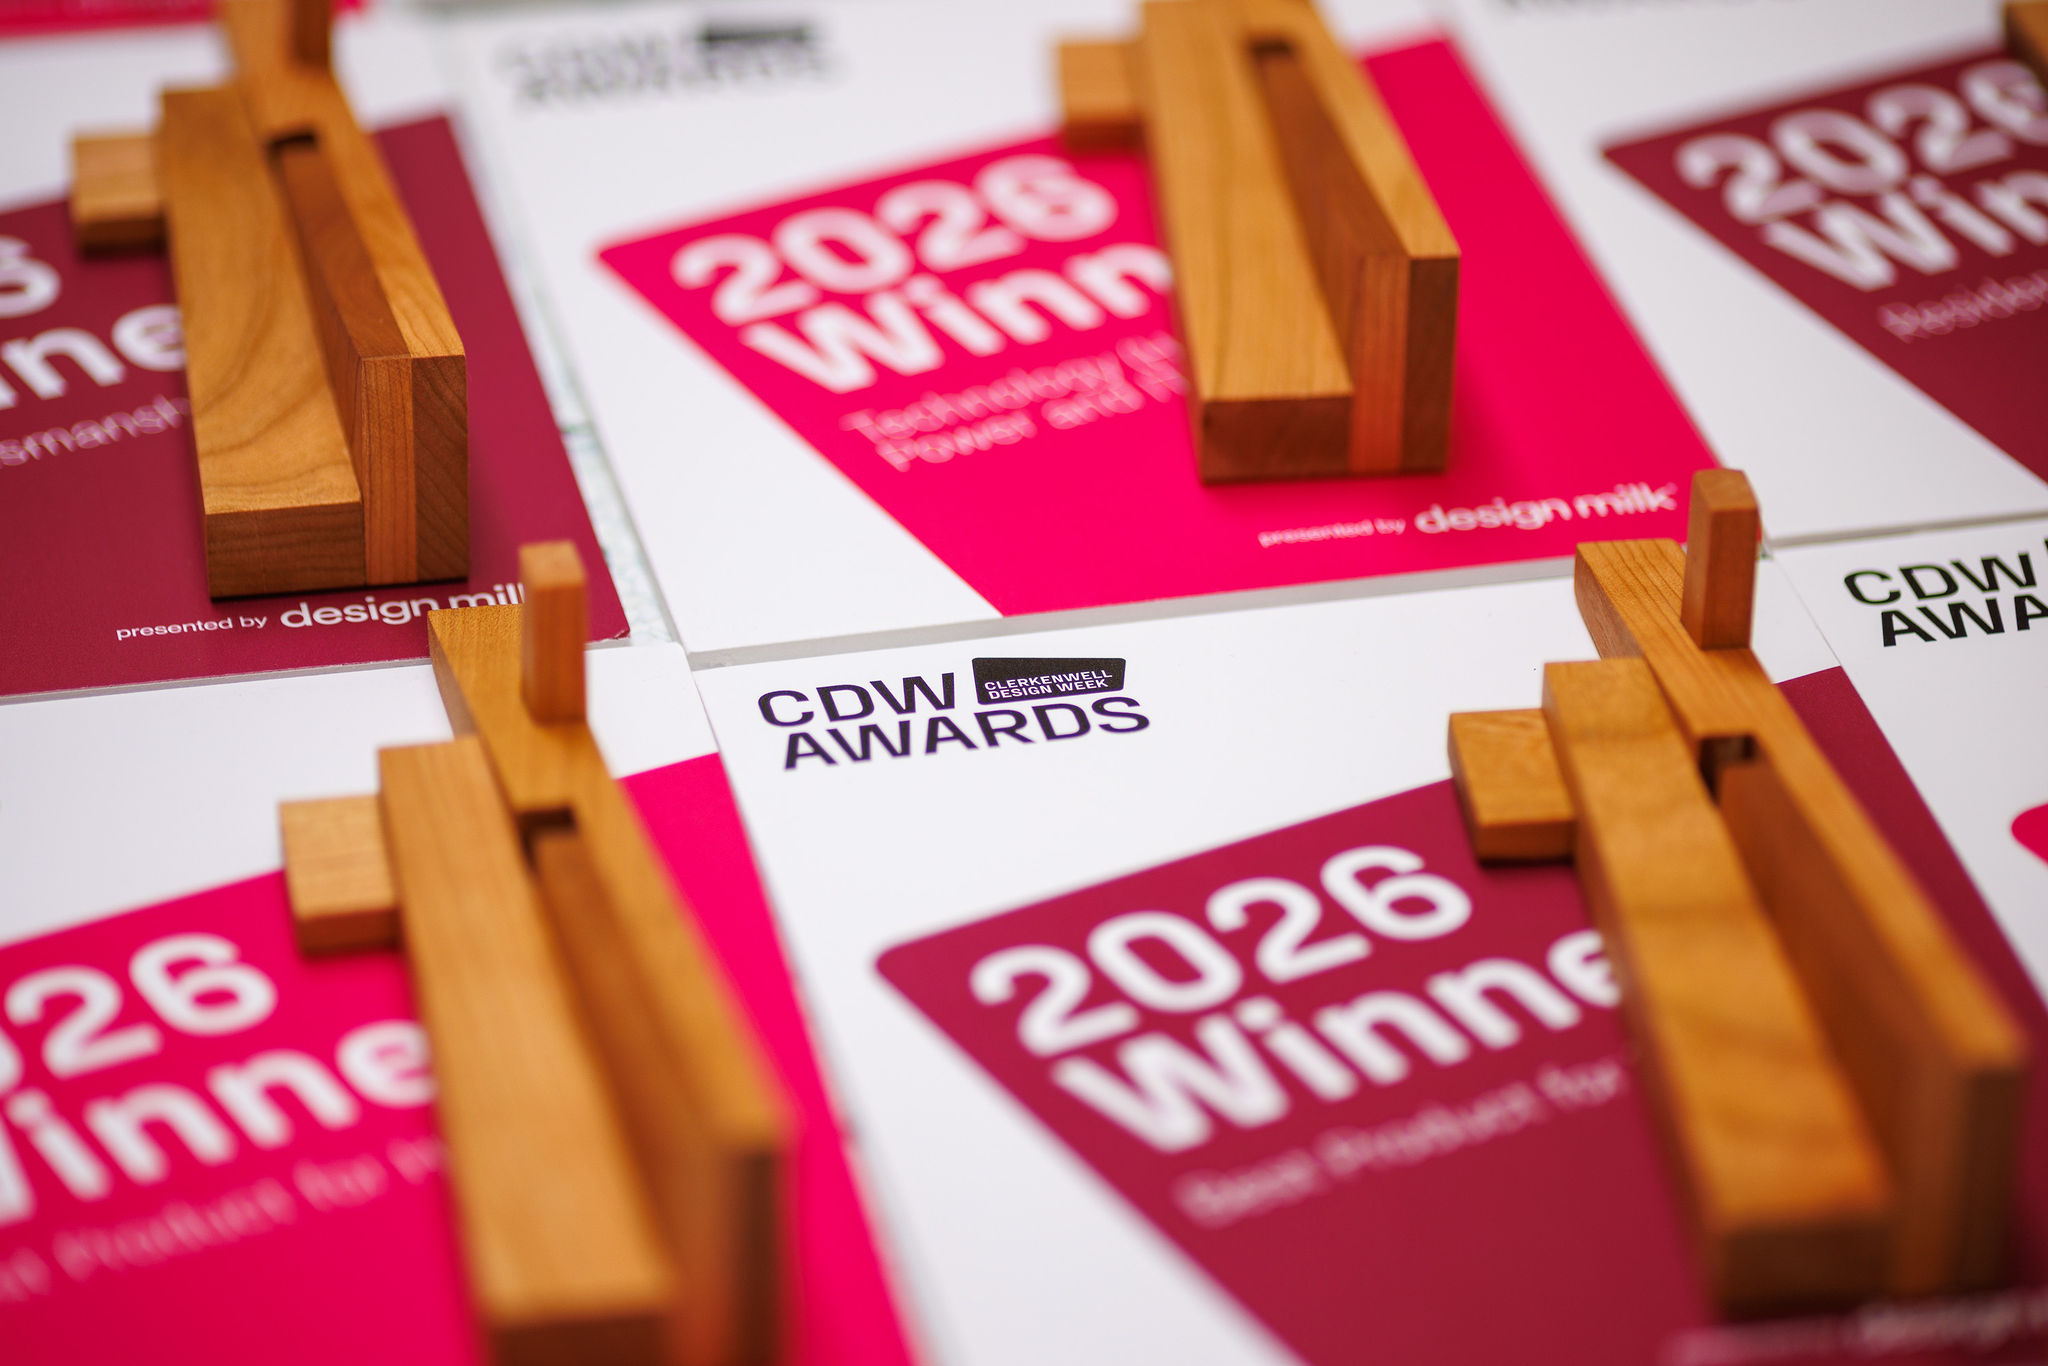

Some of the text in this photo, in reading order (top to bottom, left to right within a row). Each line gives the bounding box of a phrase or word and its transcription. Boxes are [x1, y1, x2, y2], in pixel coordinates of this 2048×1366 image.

[1672, 59, 2048, 226] 2026
[672, 153, 1119, 326] 2026
[1760, 170, 2048, 291] Win
[741, 242, 1174, 395] Winn
[838, 351, 1132, 442] Technology
[875, 408, 1037, 472] Power
[1258, 481, 1678, 548] presented by design milk
[116, 616, 233, 641] presented
[239, 615, 268, 629] by
[280, 595, 440, 630] design
[1844, 552, 2037, 605] CDW
[1881, 593, 2048, 647] AWA
[757, 672, 956, 727] CDW
[984, 669, 1113, 691] CLERKENWELL
[988, 678, 1109, 700] DESIGN WEEK
[785, 696, 1151, 771] AWARDS
[970, 845, 1473, 1058] 2026
[0, 932, 278, 1092] 26
[1049, 929, 1622, 1153] Winne
[0, 1019, 438, 1228] inne
